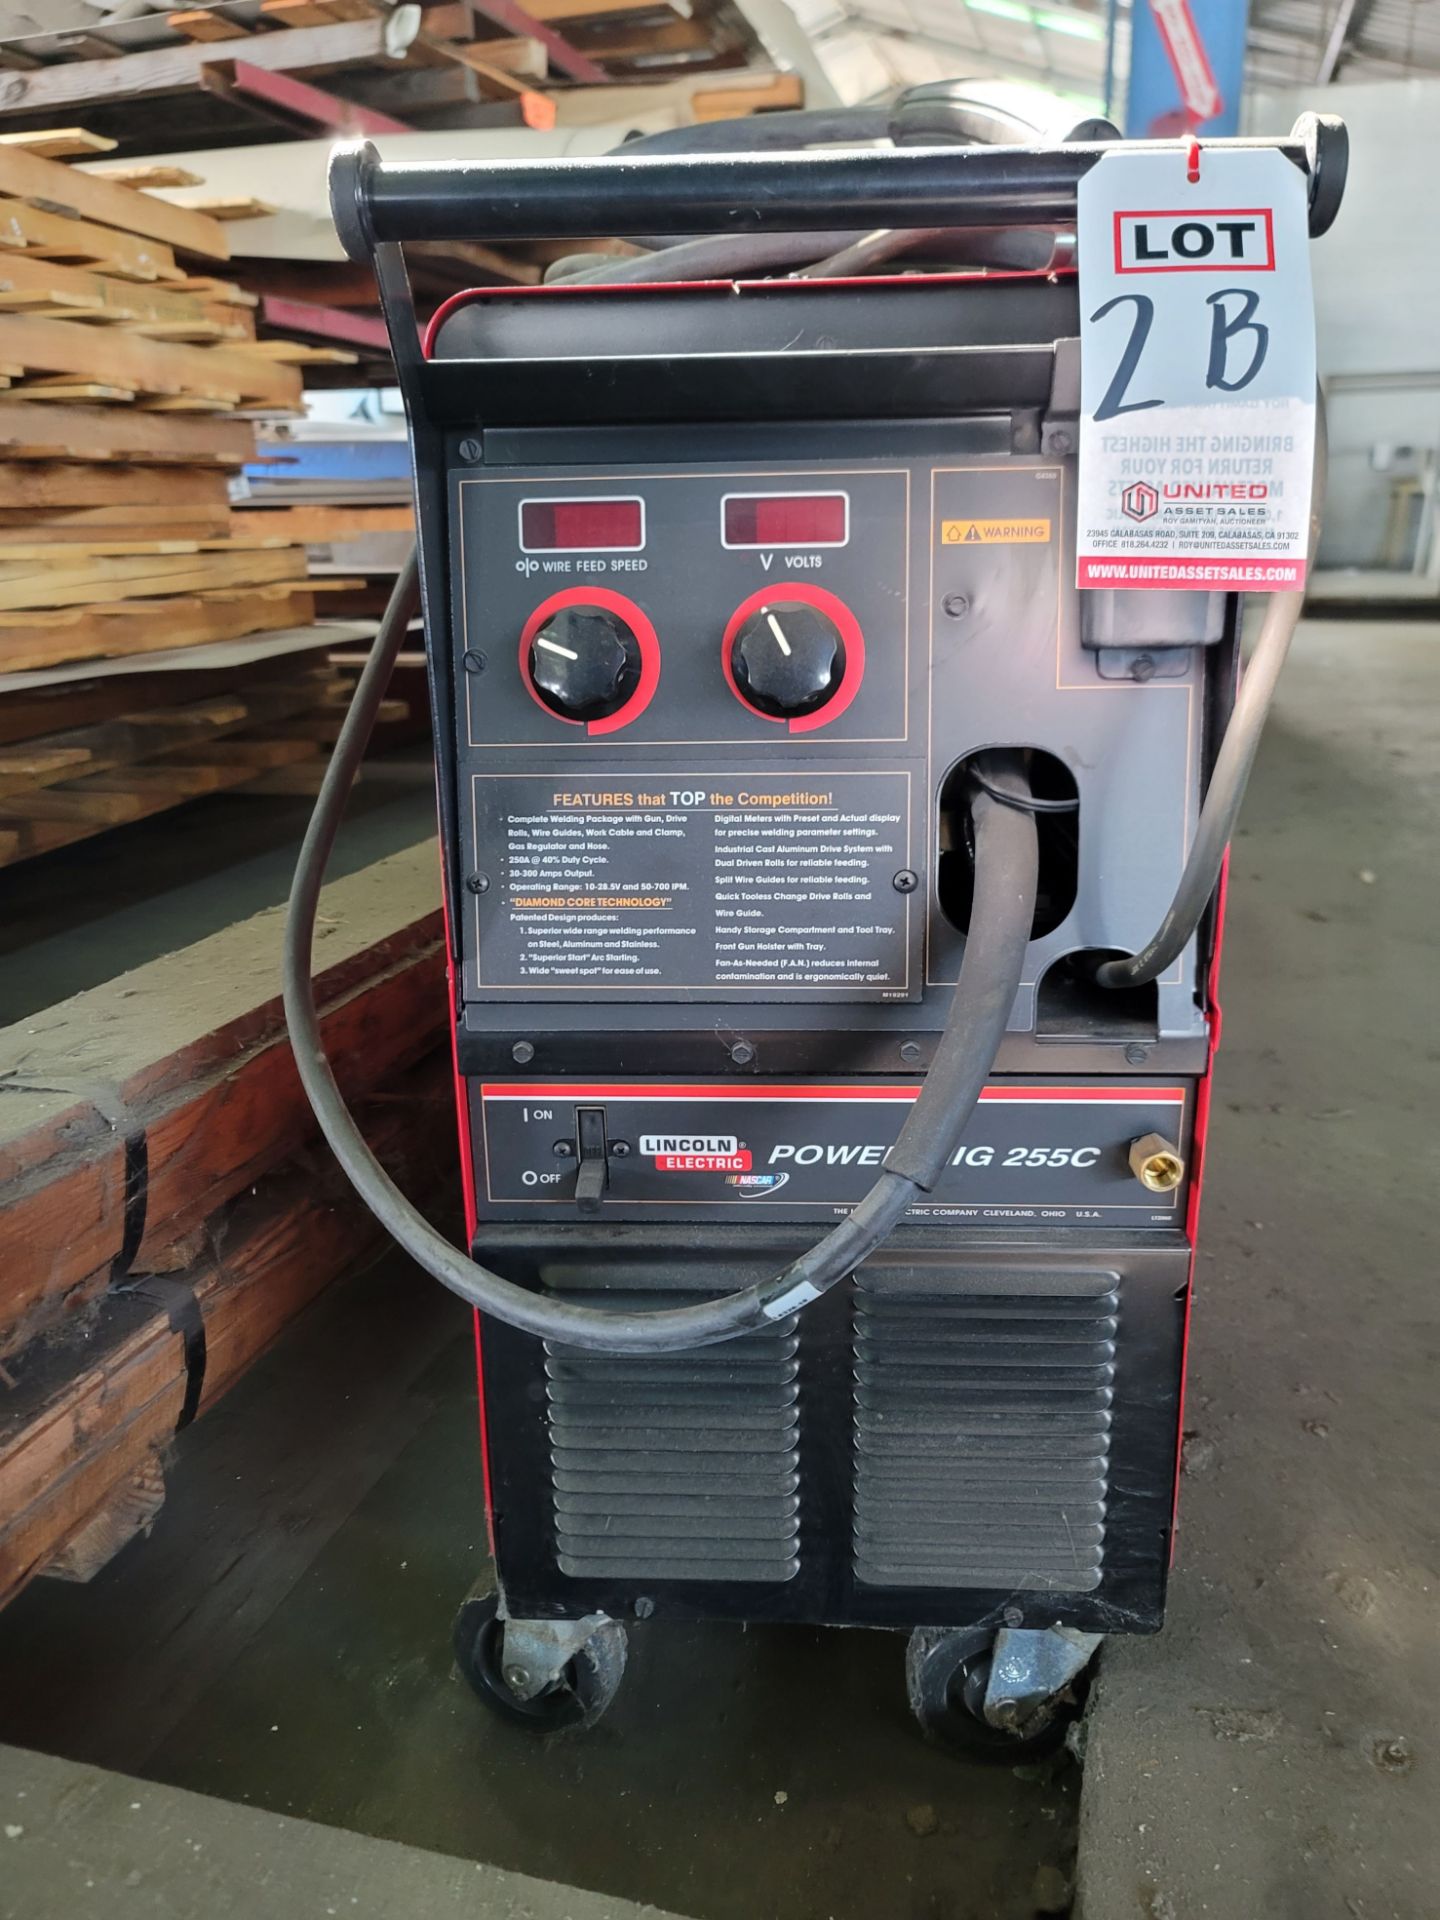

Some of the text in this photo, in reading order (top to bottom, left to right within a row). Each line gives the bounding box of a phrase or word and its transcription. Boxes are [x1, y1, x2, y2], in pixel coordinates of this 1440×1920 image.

[1135, 223, 1255, 260] LOT
[1090, 288, 1269, 422] 2 B
[1163, 484, 1268, 499] UNITED
[1163, 507, 1214, 515] ASSET
[1216, 507, 1266, 515] SALES
[983, 526, 1044, 537] WARNING
[1086, 530, 1299, 540] 23945 CALABASAS ROAD, SUITE 209, CALABASAS, CA 91302
[1093, 540, 1290, 550] OFFICE 818.264.4232 ROY@UNITEDASSETSALES.COM
[543, 559, 648, 572] WIRE FEED SPEED
[760, 554, 821, 571] V VOLTS
[1088, 565, 1296, 581] WWW.UNITEDASSETSALES.COM
[554, 791, 832, 808] FEATURES that TOP the Competition!
[508, 816, 548, 824] Complete
[550, 815, 584, 824] Welding
[586, 815, 624, 824] Package
[644, 815, 664, 824] Gun,
[666, 814, 688, 822] Drive
[714, 815, 742, 824] Digital
[793, 814, 820, 822] Preset
[821, 814, 839, 822] and
[840, 814, 868, 822] Actual
[869, 814, 901, 823] display
[552, 829, 584, 837] Guides,
[608, 828, 634, 836] Cable
[654, 828, 686, 837] Clamp,
[728, 828, 760, 837] precise
[761, 828, 795, 838] welding
[796, 828, 841, 837] parameter
[843, 828, 878, 838] settings.
[755, 845, 775, 853] Cast
[843, 845, 874, 854] System
[531, 856, 540, 864] @
[562, 856, 580, 864] Duty
[582, 856, 609, 864] Cycle.
[539, 870, 562, 878] Amps
[564, 870, 594, 878] Output.
[509, 883, 551, 892] Operating
[553, 883, 582, 892] Range:
[566, 898, 596, 906] CORE
[741, 892, 772, 900] Tooless
[773, 892, 808, 902] Change
[809, 892, 831, 900] Drive
[832, 892, 853, 900] Rolls
[854, 892, 872, 900] and
[548, 914, 576, 922] Design
[577, 914, 619, 922] produces:
[528, 926, 562, 936] Superior
[584, 928, 608, 936] range
[609, 927, 642, 936] welding
[642, 927, 696, 935] performance
[715, 926, 742, 935] Handy
[744, 926, 776, 935] Storage
[778, 926, 836, 934] Compartment
[837, 926, 854, 934] and
[875, 926, 895, 934] Tray.
[539, 940, 562, 948] Steel,
[562, 940, 603, 948] Aluminum
[604, 940, 620, 948] and
[621, 940, 660, 948] Stainless.
[738, 942, 755, 950] Gun
[806, 943, 826, 951] Tray.
[606, 954, 640, 963] Starting.
[780, 959, 810, 968] (F.A.N.)
[715, 972, 776, 980] contamination
[804, 973, 864, 982] ergonomically
[866, 973, 889, 982] quiet.
[534, 1110, 552, 1120] ON
[646, 1139, 732, 1152] LINCOLN
[768, 1145, 1101, 1167] POWE 255C
[666, 1157, 743, 1169] ELECTRIC
[540, 1174, 561, 1184] OFF
[740, 1175, 773, 1184] NASCAR
